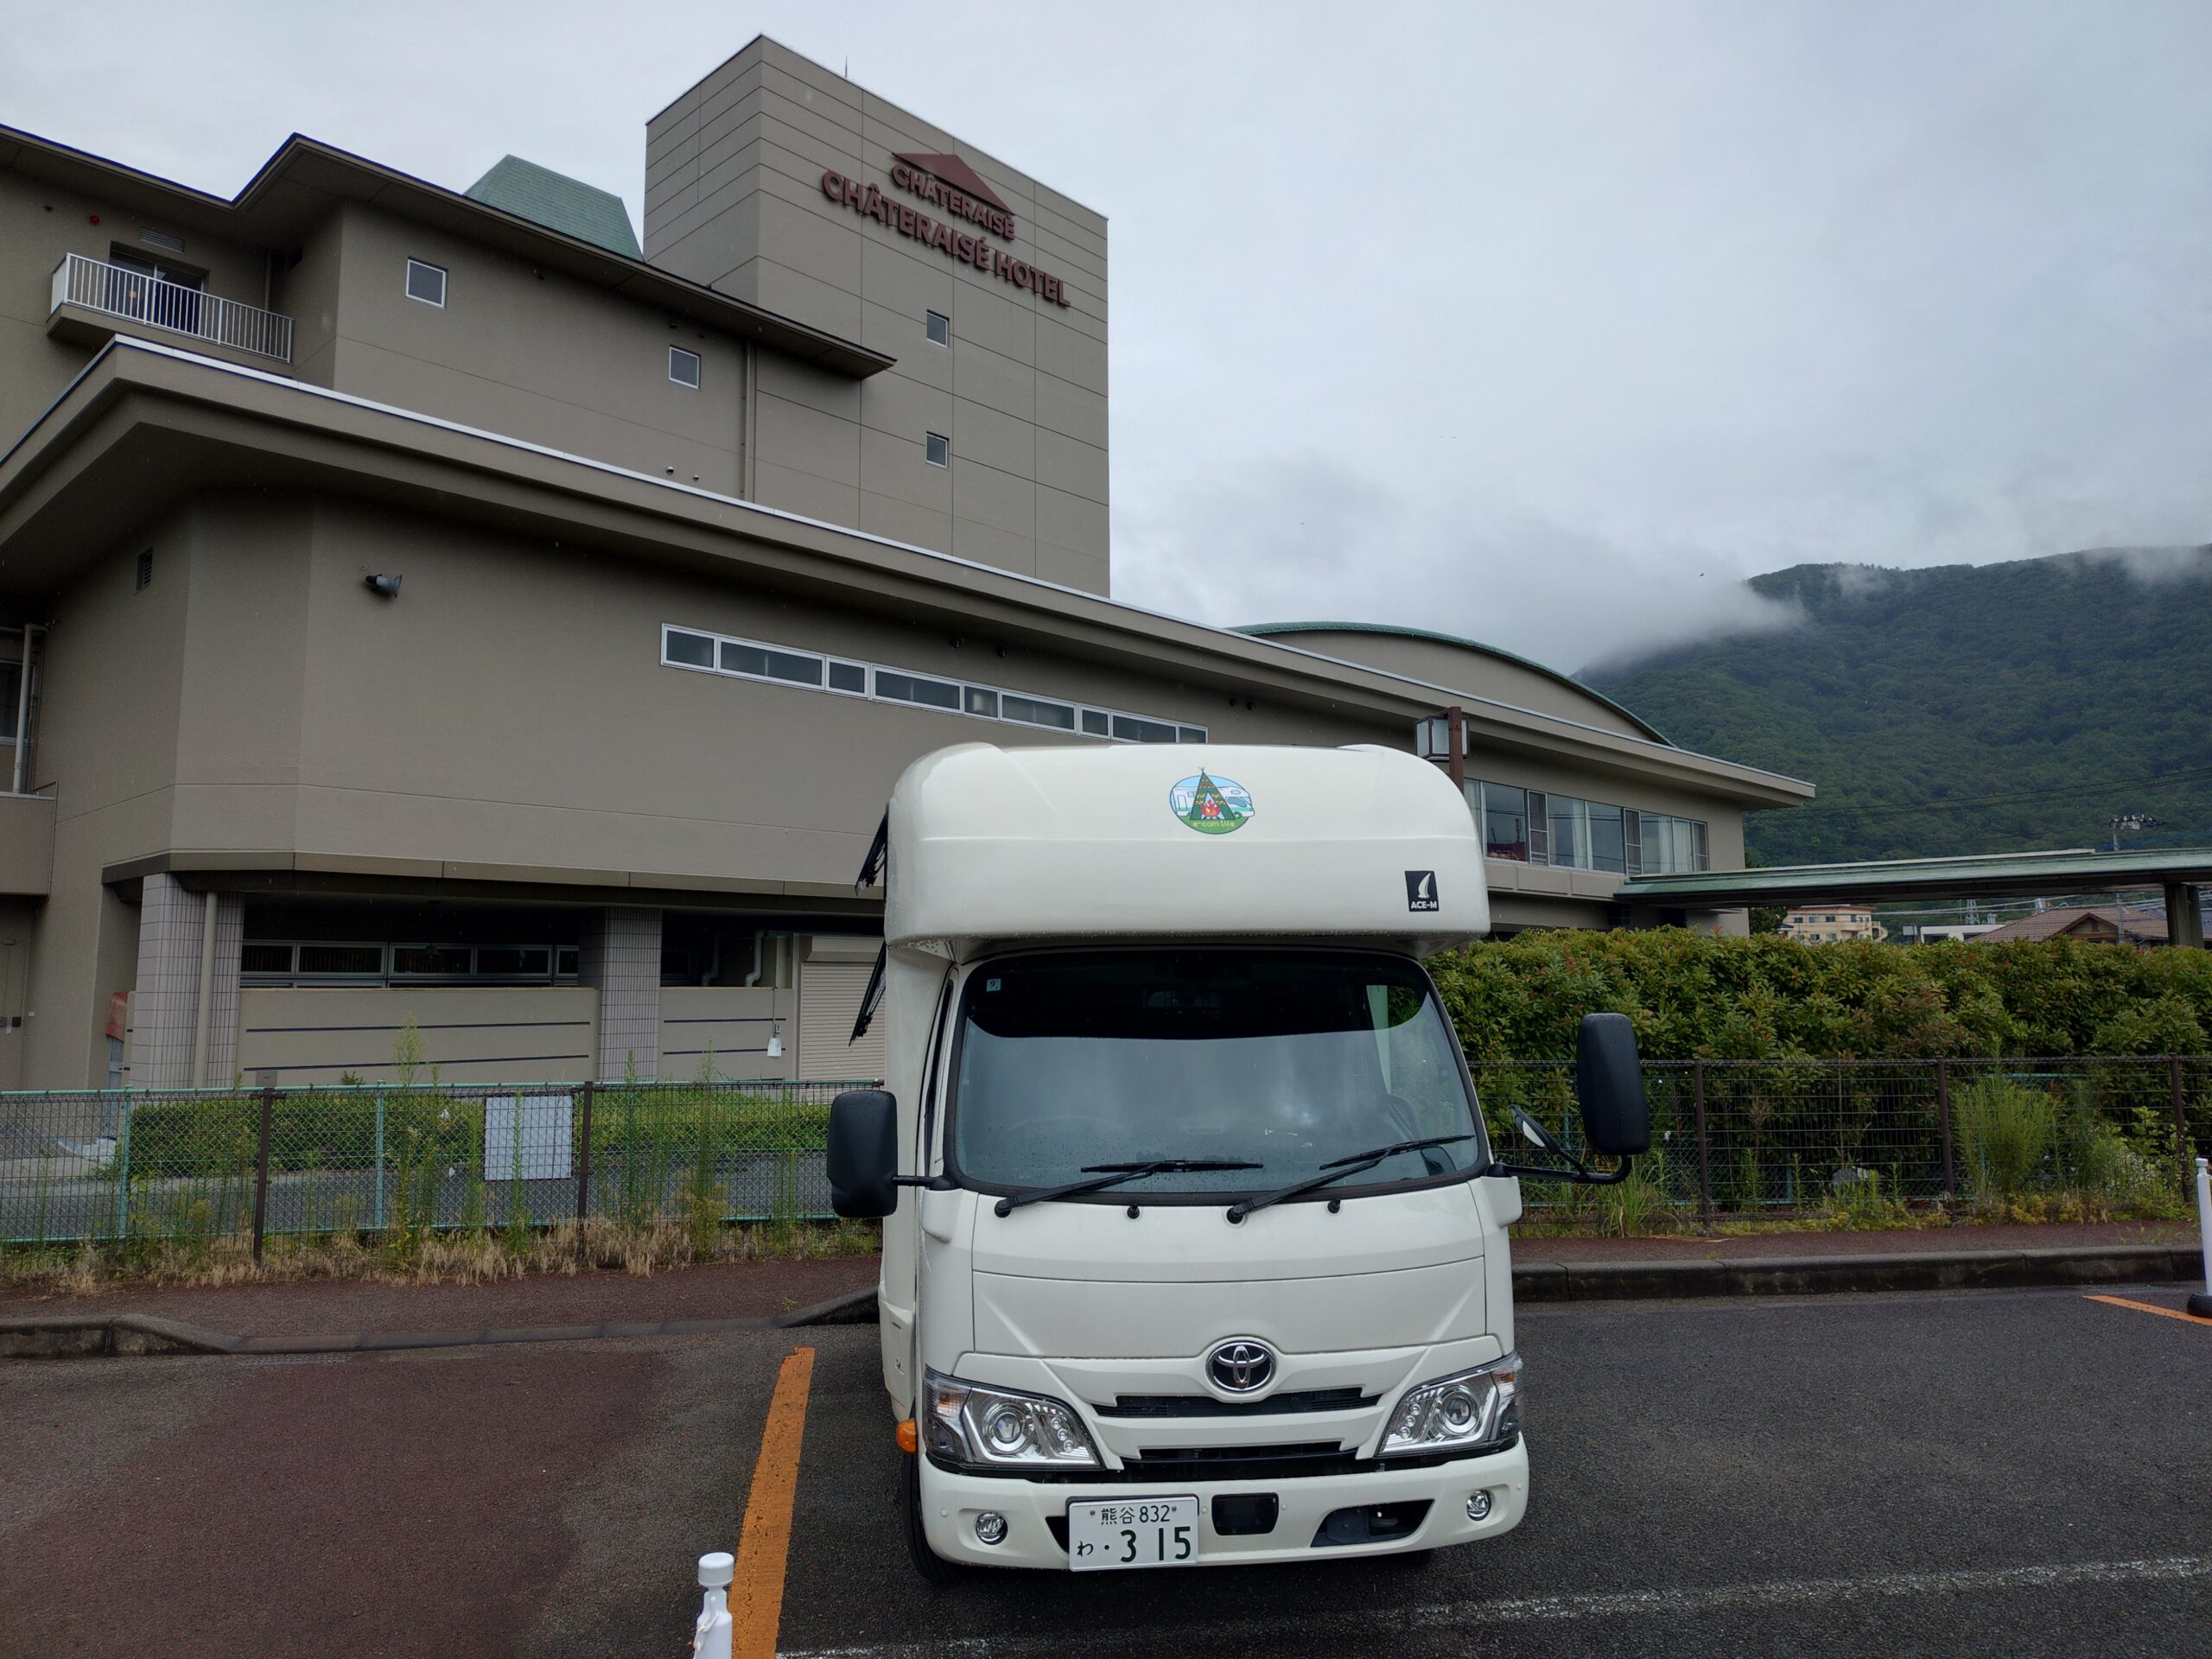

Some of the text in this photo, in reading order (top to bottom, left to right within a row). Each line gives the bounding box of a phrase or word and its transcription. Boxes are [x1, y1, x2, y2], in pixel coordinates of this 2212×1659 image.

[891, 162, 1015, 240] CHÂTERAISÉ
[822, 170, 1071, 308] CHÂTERAISÉ HOTEL
[1410, 900, 1438, 909] ACE-M
[1101, 1504, 1170, 1525] 熊谷 832
